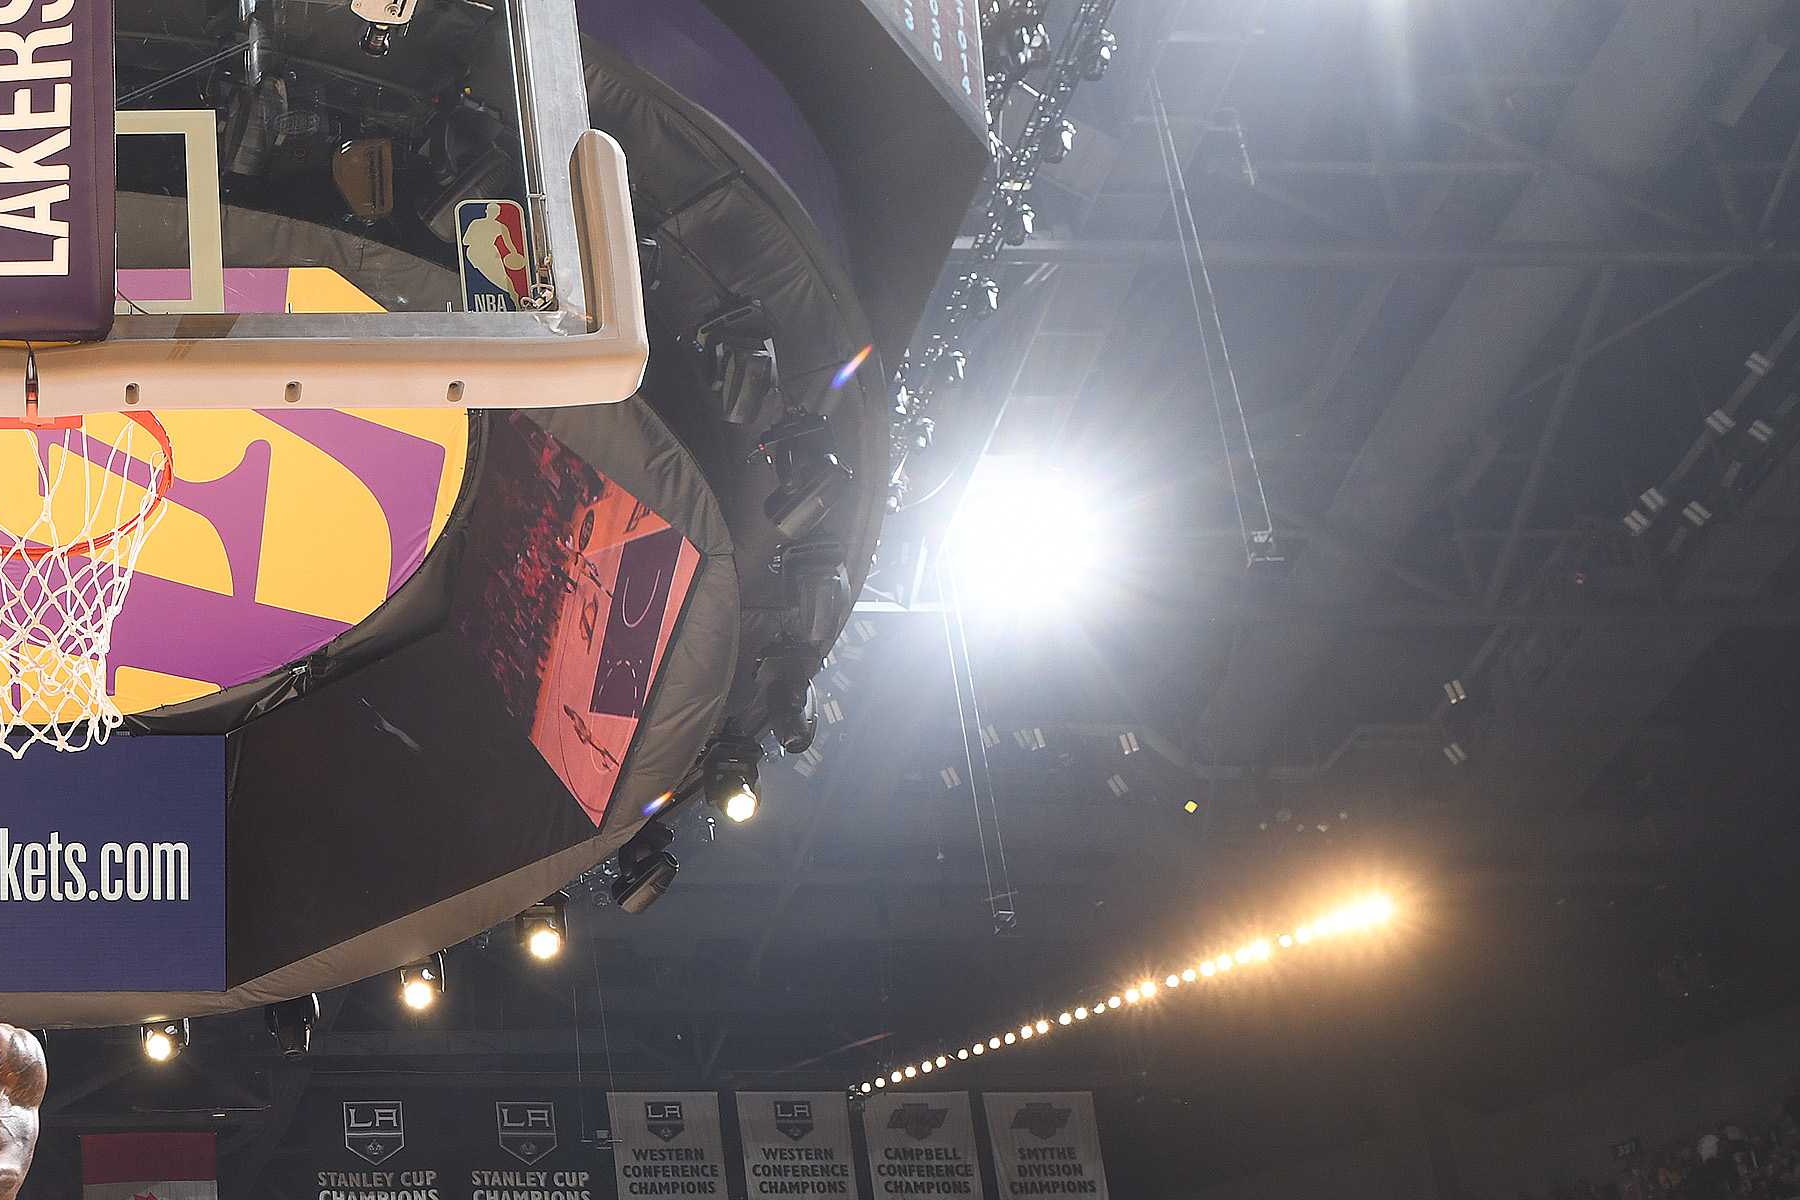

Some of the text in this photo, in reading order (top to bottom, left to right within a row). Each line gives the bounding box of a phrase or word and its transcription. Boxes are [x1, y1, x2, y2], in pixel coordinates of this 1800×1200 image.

[473, 294, 508, 311] NBA
[348, 1107, 399, 1128] LA
[501, 1107, 551, 1128] LA
[632, 1148, 706, 1162] WESTERN
[762, 1147, 835, 1161] WESTERN
[883, 1147, 962, 1161] CAMPBELL
[1018, 1147, 1077, 1161] SMYTHE
[622, 1164, 719, 1178] CONFERENCE
[752, 1164, 849, 1178] CONFERENCE
[876, 1163, 974, 1178] CONFERENCE
[1017, 1163, 1084, 1178] DIVISION
[317, 1170, 438, 1188] STANLEY CUP
[471, 1170, 590, 1188] STANLEY CUP
[628, 1180, 718, 1195] CHAMPIONS
[758, 1180, 847, 1194] CHAMPIONS
[883, 1180, 972, 1194] CHAMPIONS
[1009, 1180, 1097, 1195] CHAMPIONS
